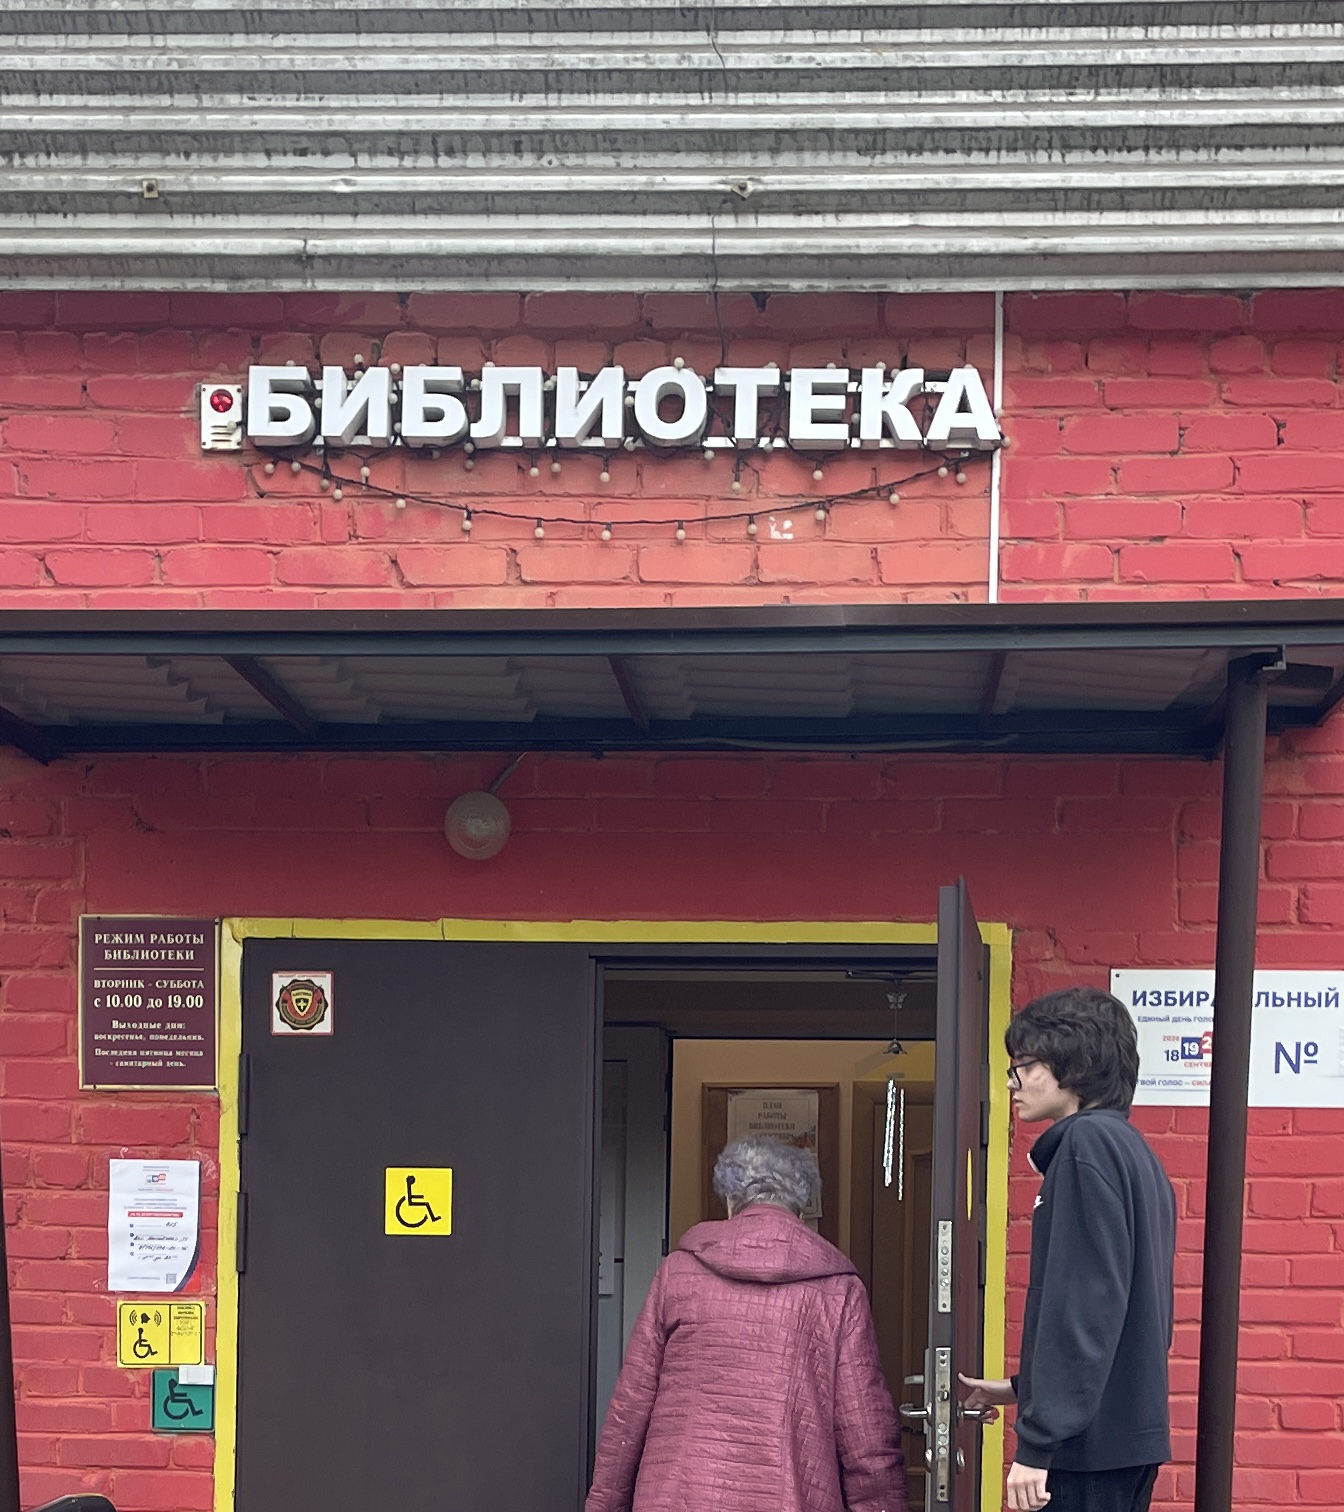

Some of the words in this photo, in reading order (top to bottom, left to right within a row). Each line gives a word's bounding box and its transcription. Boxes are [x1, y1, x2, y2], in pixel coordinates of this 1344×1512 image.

[247, 365, 1002, 450] БИБЛИОТЕКА
[94, 933, 145, 945] РЕЖИМ
[150, 933, 204, 945] РАБОТЫ
[104, 949, 195, 960] БИБЛИОТЕКИ
[94, 979, 145, 989] ВТОРНИК
[155, 979, 205, 989] СУББОТА
[105, 994, 142, 1008] 10.00
[147, 998, 163, 1009] до
[167, 994, 204, 1008] 19.00
[1132, 987, 1339, 1008] ИЗБИРЛЬНЫЙ
[112, 1020, 162, 1030] Выходные
[1164, 1050, 1179, 1062] 18
[1183, 1042, 1199, 1056] 19
[1274, 1041, 1319, 1074] №
